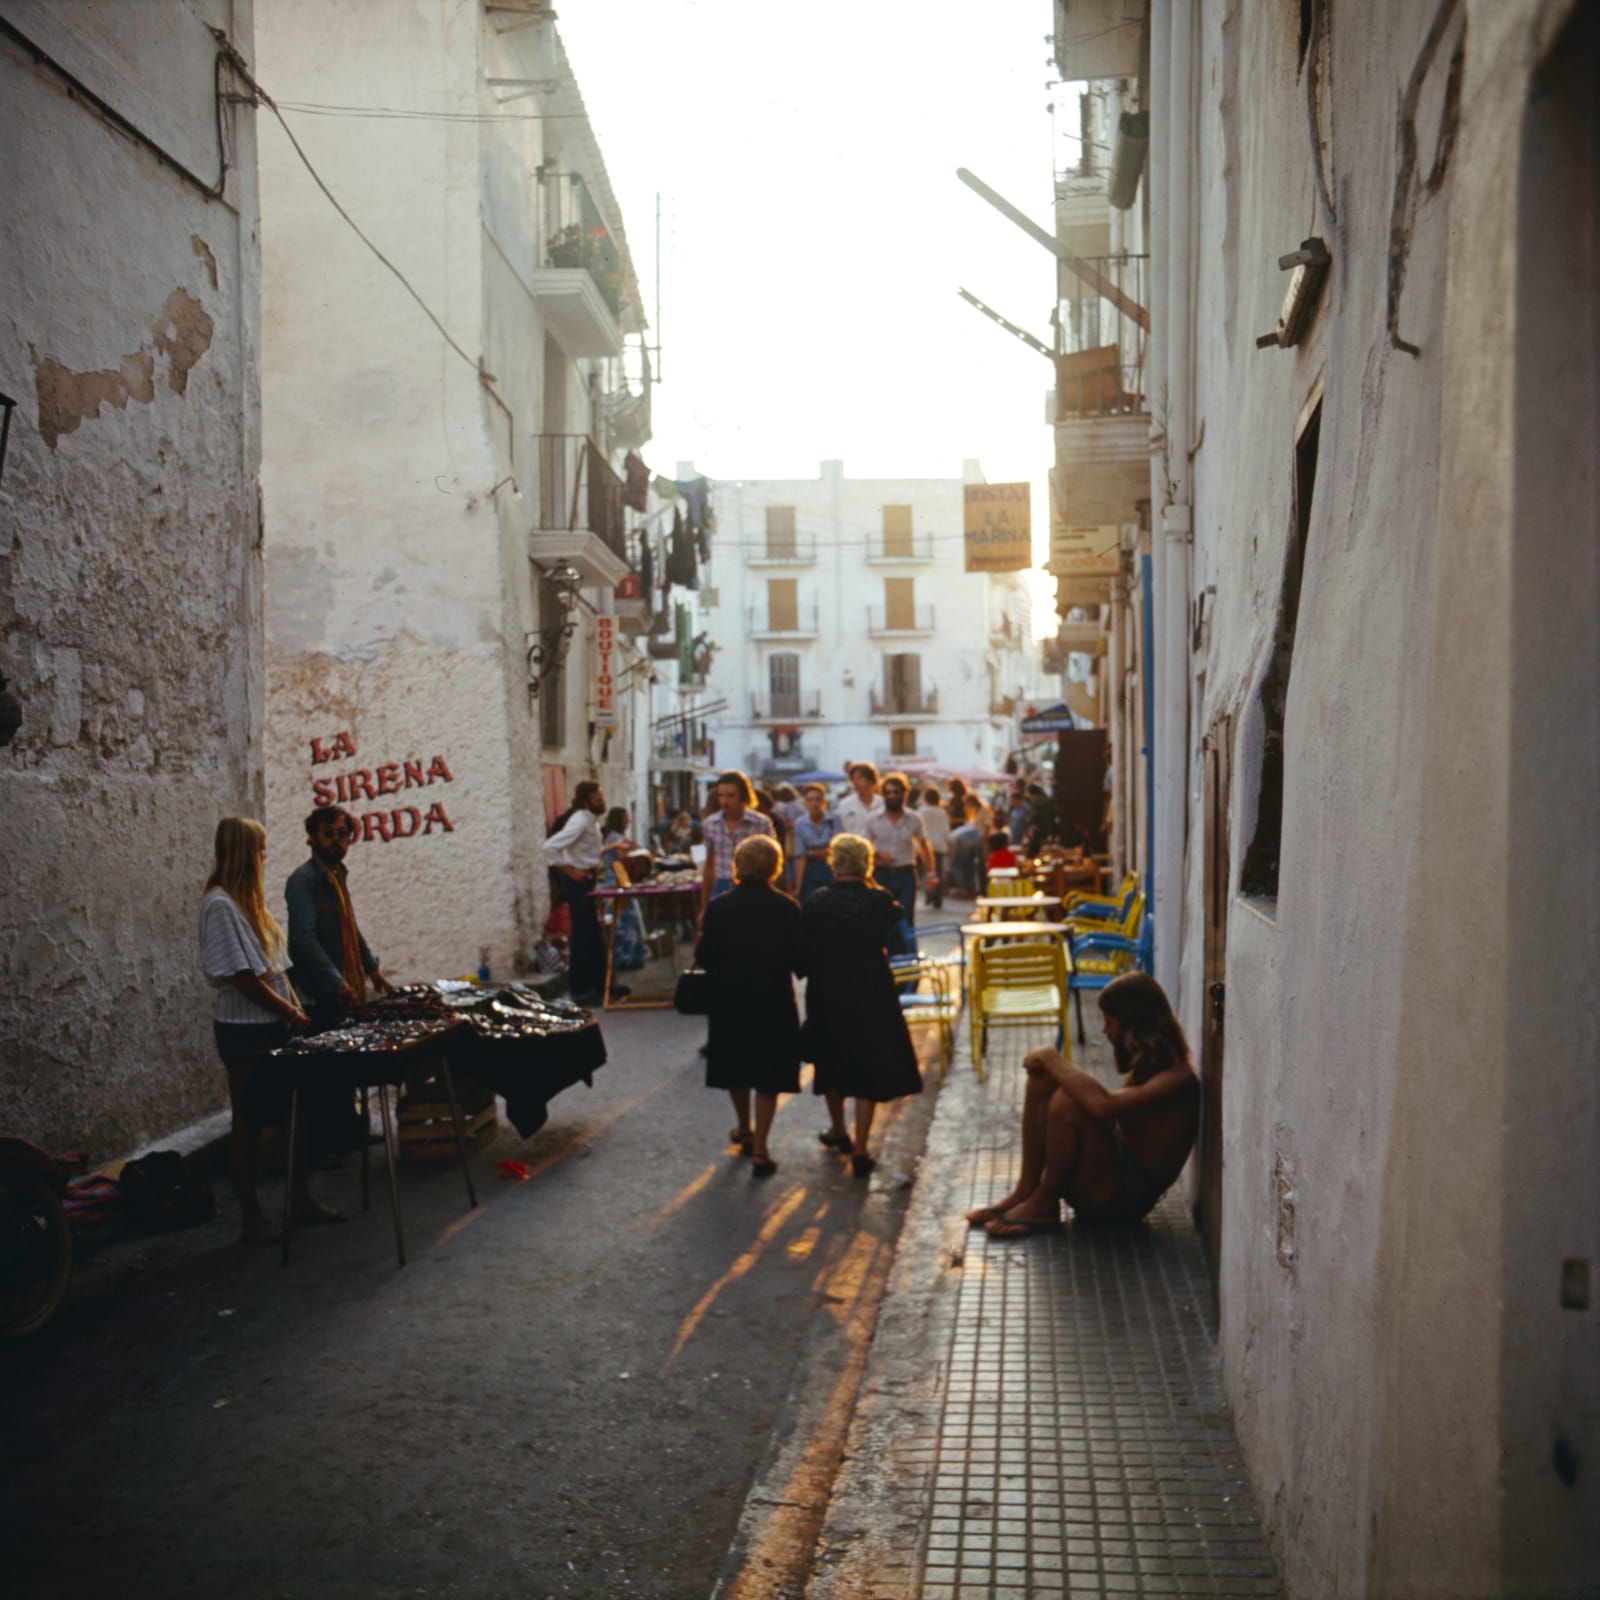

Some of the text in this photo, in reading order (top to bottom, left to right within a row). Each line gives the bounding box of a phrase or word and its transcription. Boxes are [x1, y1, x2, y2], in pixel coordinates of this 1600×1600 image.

[597, 618, 612, 709] BOUTIQUE
[311, 731, 356, 765] LA
[312, 755, 453, 807] SIRENA
